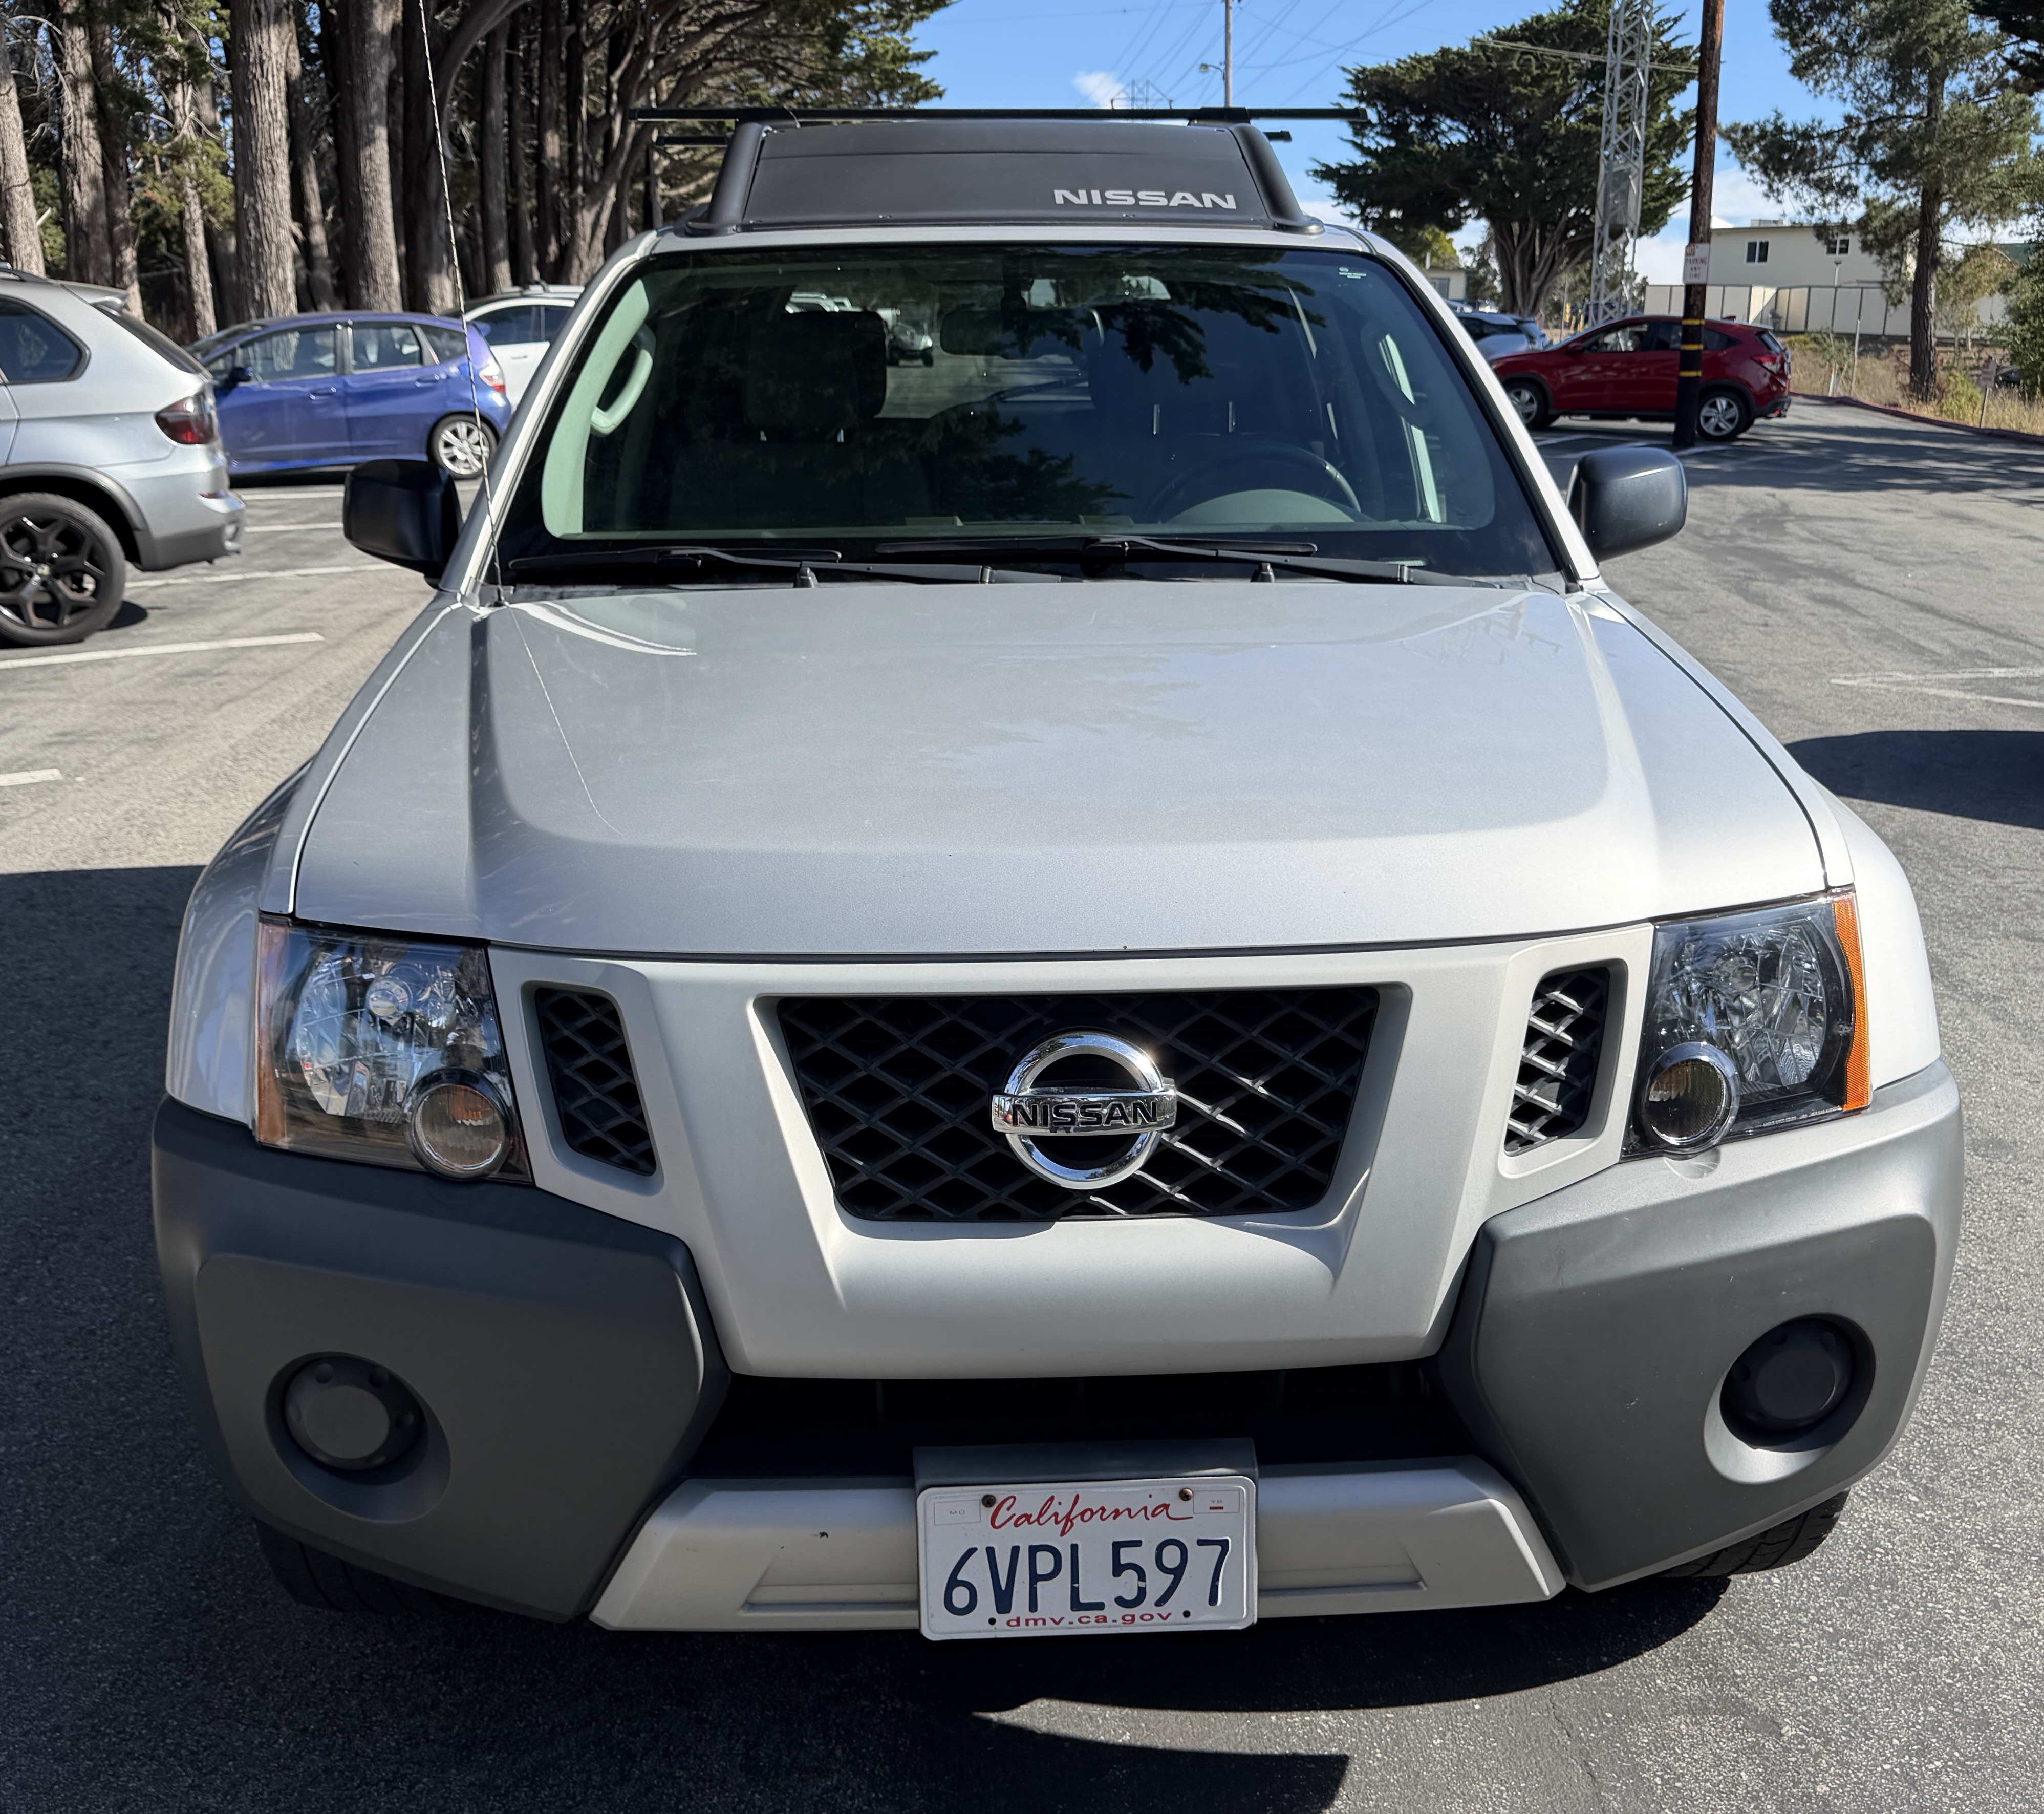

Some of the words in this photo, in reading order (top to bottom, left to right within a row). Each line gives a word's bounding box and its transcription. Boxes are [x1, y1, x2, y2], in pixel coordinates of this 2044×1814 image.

[1053, 189, 1237, 209] NISSAN
[1012, 1101, 1158, 1127] NISSAN
[990, 1493, 1193, 1537] California
[943, 1538, 1230, 1616] 6VPL597
[1006, 1612, 1172, 1627] dmv.ca.gov
